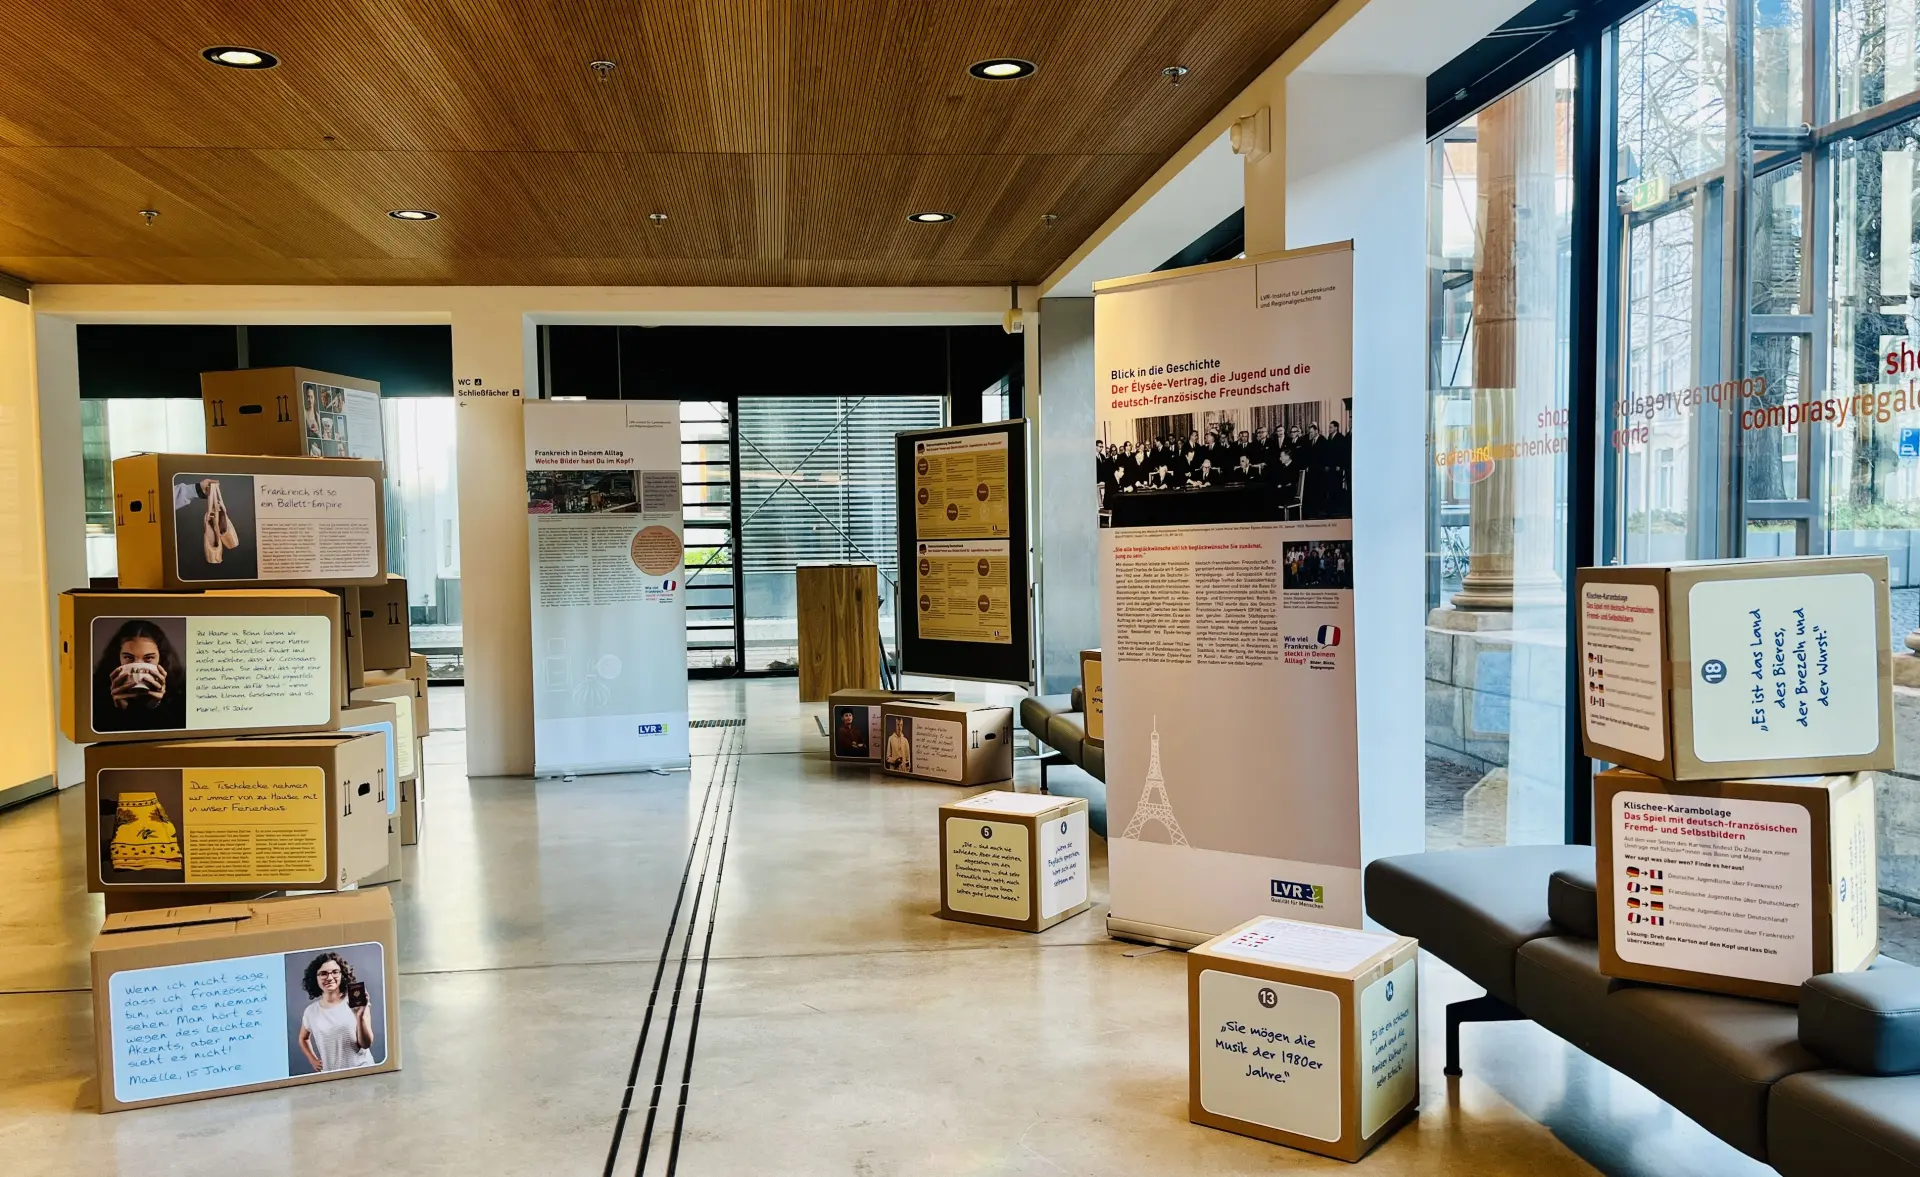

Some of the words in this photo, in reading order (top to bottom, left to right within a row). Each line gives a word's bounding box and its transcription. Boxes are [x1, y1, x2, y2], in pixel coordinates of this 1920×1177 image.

[1261, 292, 1290, 301] LVR-Institut
[1301, 286, 1335, 295] Landeskunde
[1271, 296, 1321, 307] Regionalgeschichte
[1112, 371, 1135, 380] Blick
[1138, 368, 1146, 377] in
[1149, 366, 1163, 376] die
[1167, 359, 1220, 374] Geschichte
[1887, 342, 1920, 375] sh
[1112, 384, 1128, 394] Der
[1131, 375, 1207, 393] Élysée-Vertrag,
[1210, 372, 1225, 383] die
[1228, 368, 1266, 383] Jugend
[1270, 366, 1290, 377] und
[1294, 363, 1310, 374] die
[458, 389, 509, 397] Schließfächer
[1112, 390, 1216, 408] deutsch-französische
[1220, 381, 1290, 398] Freundschaft
[1742, 379, 1920, 432] comprasyregal
[1903, 430, 1912, 441] P
[261, 485, 310, 496] Frankreich
[277, 498, 342, 511] Ballett-Empire
[1749, 609, 1762, 646] Land
[1793, 608, 1805, 635] und
[1773, 628, 1786, 676] Bieres,
[1813, 626, 1828, 675] Wurst.“
[1705, 663, 1722, 681] 18
[1751, 652, 1762, 679] das
[1793, 641, 1808, 694] Brezeln
[1752, 685, 1764, 704] ist
[1774, 682, 1785, 708] des
[1818, 680, 1829, 706] der
[1752, 709, 1768, 731] „Es
[1796, 701, 1808, 727] der
[190, 781, 209, 789] Die
[214, 781, 268, 789] Tischdecke
[1624, 802, 1731, 818] Klischee-Karambolage
[984, 828, 990, 836] 5
[1624, 812, 1640, 820] Das
[1643, 814, 1666, 822] Spiel
[1669, 816, 1684, 824] mit
[1687, 818, 1798, 833] deutsch-französischen
[1624, 823, 1658, 832] Fremd-
[1661, 826, 1678, 834] und
[1681, 828, 1745, 840] Selbstbildern
[1721, 863, 1744, 871] heraus!
[1274, 882, 1302, 898] LVR
[1668, 873, 1694, 881] Deutsche
[1697, 876, 1730, 885] Jugendliche
[1747, 882, 1782, 890] Frankreich?
[1299, 901, 1323, 909] Menschen
[125, 985, 159, 994] Wenn
[167, 982, 186, 990] ich
[194, 975, 228, 986] nicht
[235, 972, 269, 981] sage,
[125, 997, 155, 1006] dass
[163, 994, 181, 1003] ich
[191, 984, 267, 998] französisch
[1260, 991, 1275, 1004] 13
[125, 1010, 148, 1019] bin,
[156, 1006, 183, 1015] wird
[215, 995, 267, 1007] niemand
[126, 1021, 169, 1031] sehen.
[177, 1016, 204, 1025] Man
[212, 1009, 237, 1020] hört
[127, 1033, 167, 1045] wegen
[176, 1027, 199, 1037] des
[207, 1021, 261, 1033] leichten
[1221, 1021, 1246, 1034] „Sie
[1251, 1028, 1290, 1043] mögen
[1295, 1035, 1316, 1048] die
[128, 1054, 164, 1067] sieht
[195, 1045, 232, 1058] nicht!
[129, 1042, 183, 1056] Akzents,
[191, 1037, 221, 1048] aber
[229, 1034, 254, 1042] man
[1216, 1039, 1248, 1054] Musik
[1253, 1047, 1275, 1059] der
[1282, 1051, 1323, 1069] 1980er
[129, 1072, 181, 1086] Maëlle,
[186, 1069, 199, 1077] 15
[202, 1064, 243, 1075] Jahre
[1246, 1065, 1290, 1083] Jahre.“
